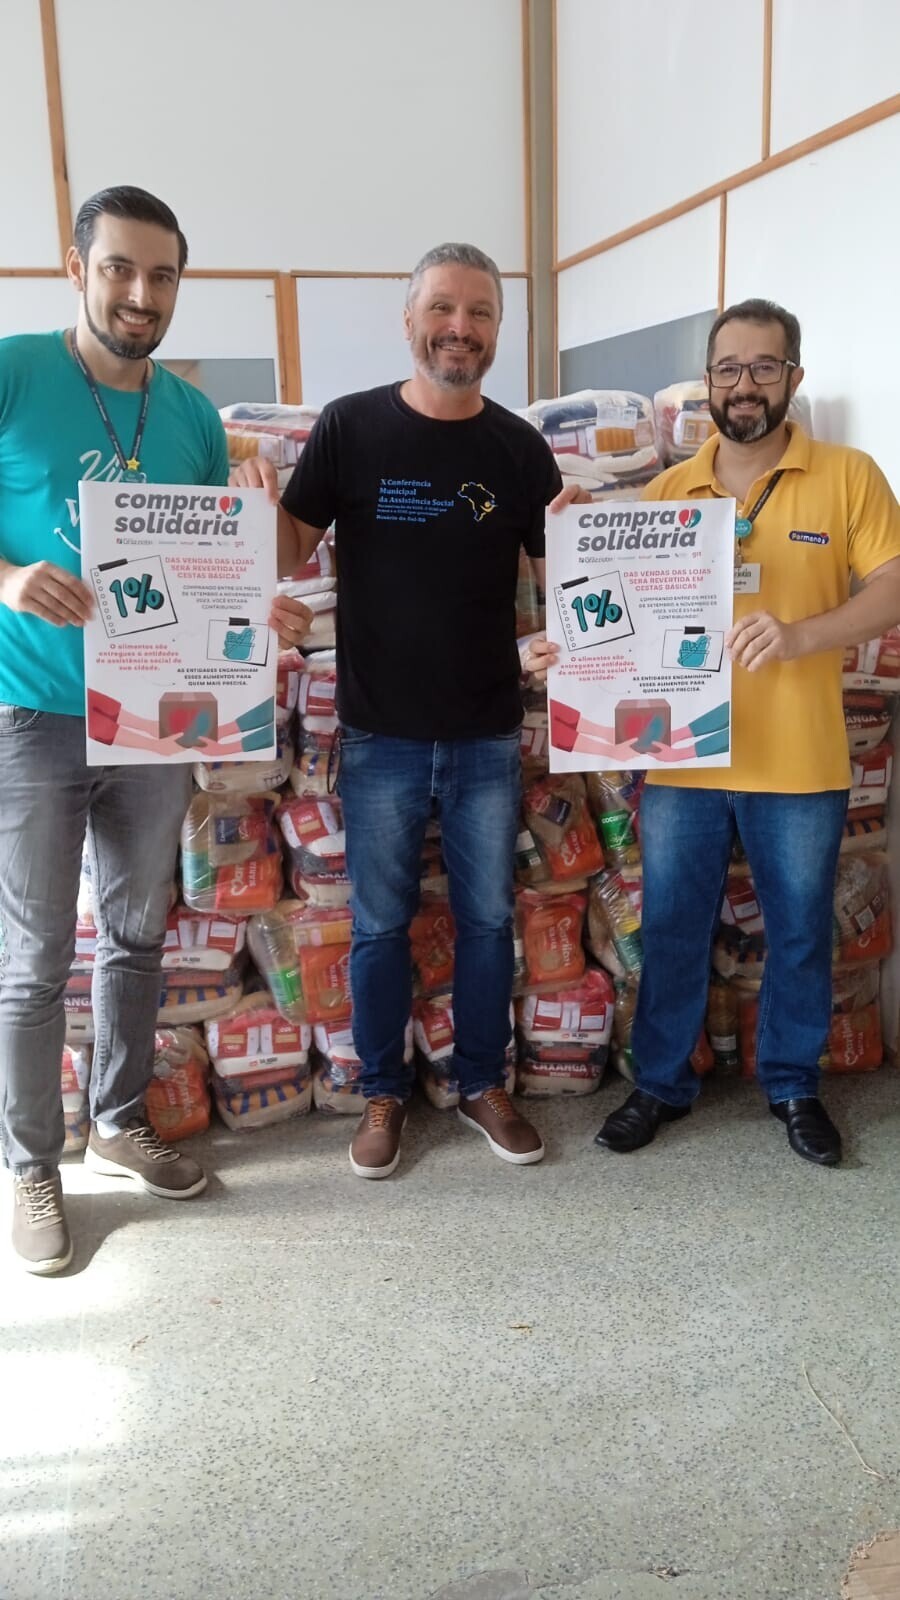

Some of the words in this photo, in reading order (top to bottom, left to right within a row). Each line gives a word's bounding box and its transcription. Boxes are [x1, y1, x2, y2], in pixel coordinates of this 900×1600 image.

[114, 492, 217, 516] compra
[379, 488, 416, 496] Municipal
[389, 496, 431, 505] Assistência
[114, 512, 238, 536] solidária
[578, 509, 676, 532] compra
[577, 528, 696, 552] solidária
[109, 573, 165, 618] 1%
[571, 589, 623, 632] 1%
